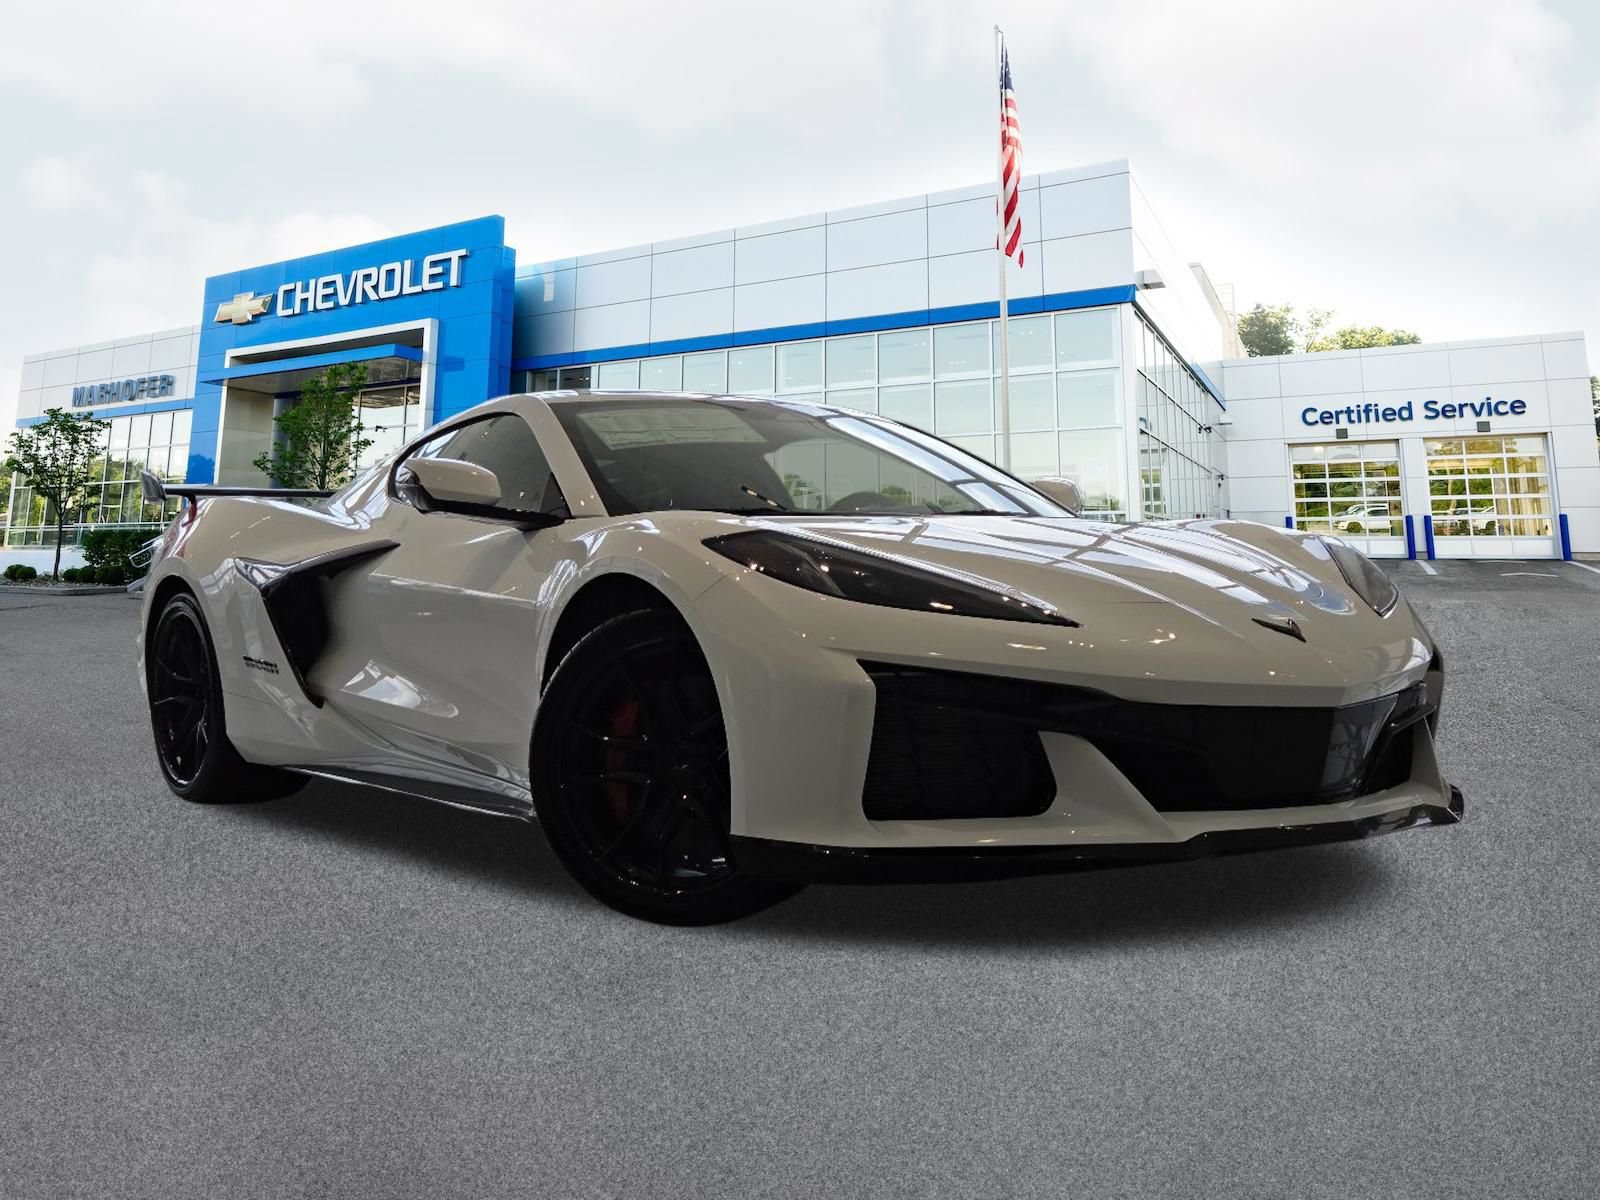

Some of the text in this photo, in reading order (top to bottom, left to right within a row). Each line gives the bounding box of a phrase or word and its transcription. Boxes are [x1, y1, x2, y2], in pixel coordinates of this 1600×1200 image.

[277, 249, 468, 317] CHEVROLET
[72, 375, 175, 407] MARHOFER
[1301, 397, 1527, 426] Certified Service
